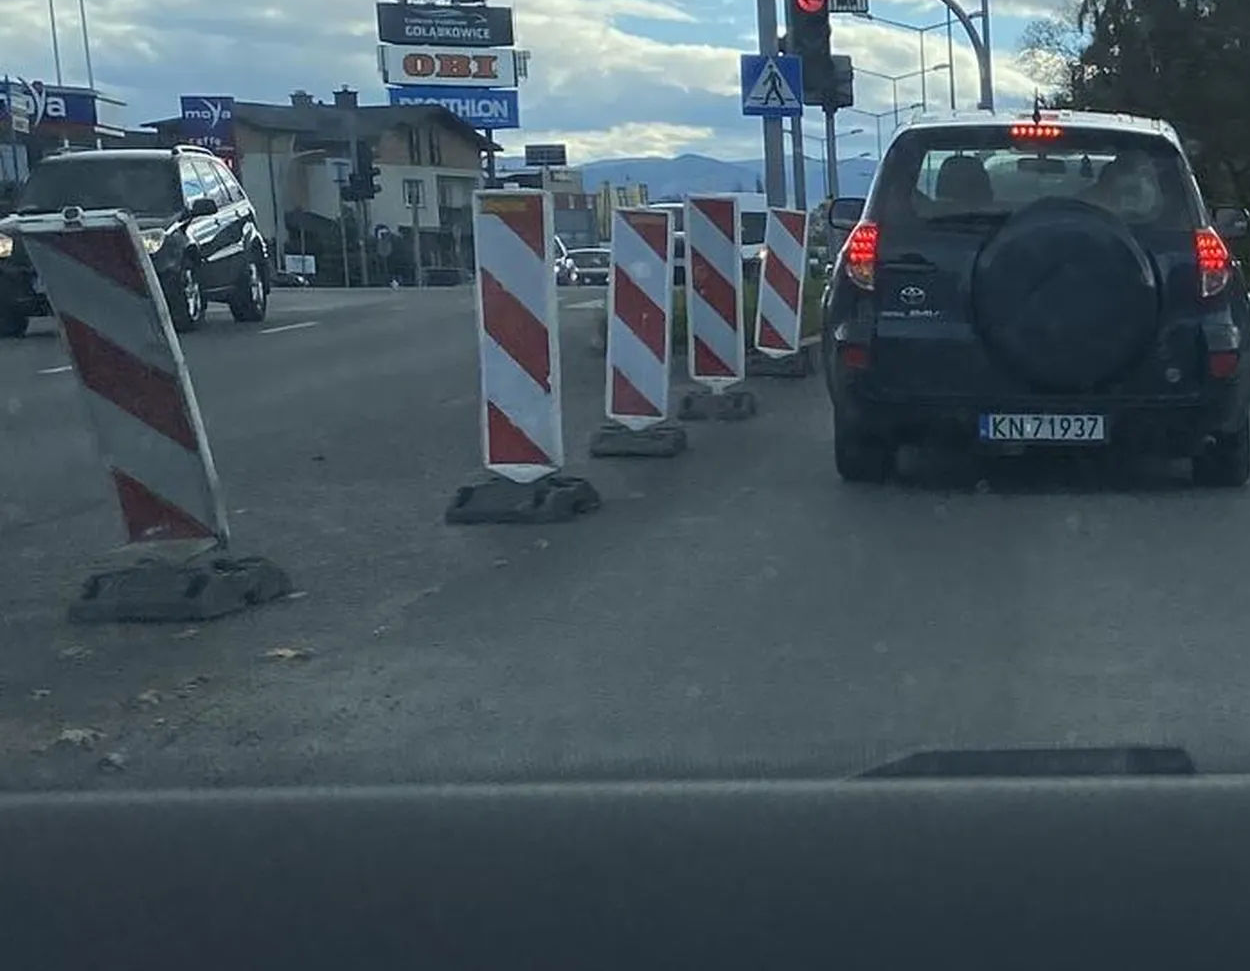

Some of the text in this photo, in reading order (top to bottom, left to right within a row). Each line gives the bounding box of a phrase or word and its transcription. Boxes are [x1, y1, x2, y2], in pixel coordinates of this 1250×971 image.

[402, 53, 498, 79] OBI
[184, 98, 231, 128] moya
[992, 417, 1025, 438] KN
[1031, 416, 1099, 438] 71937
